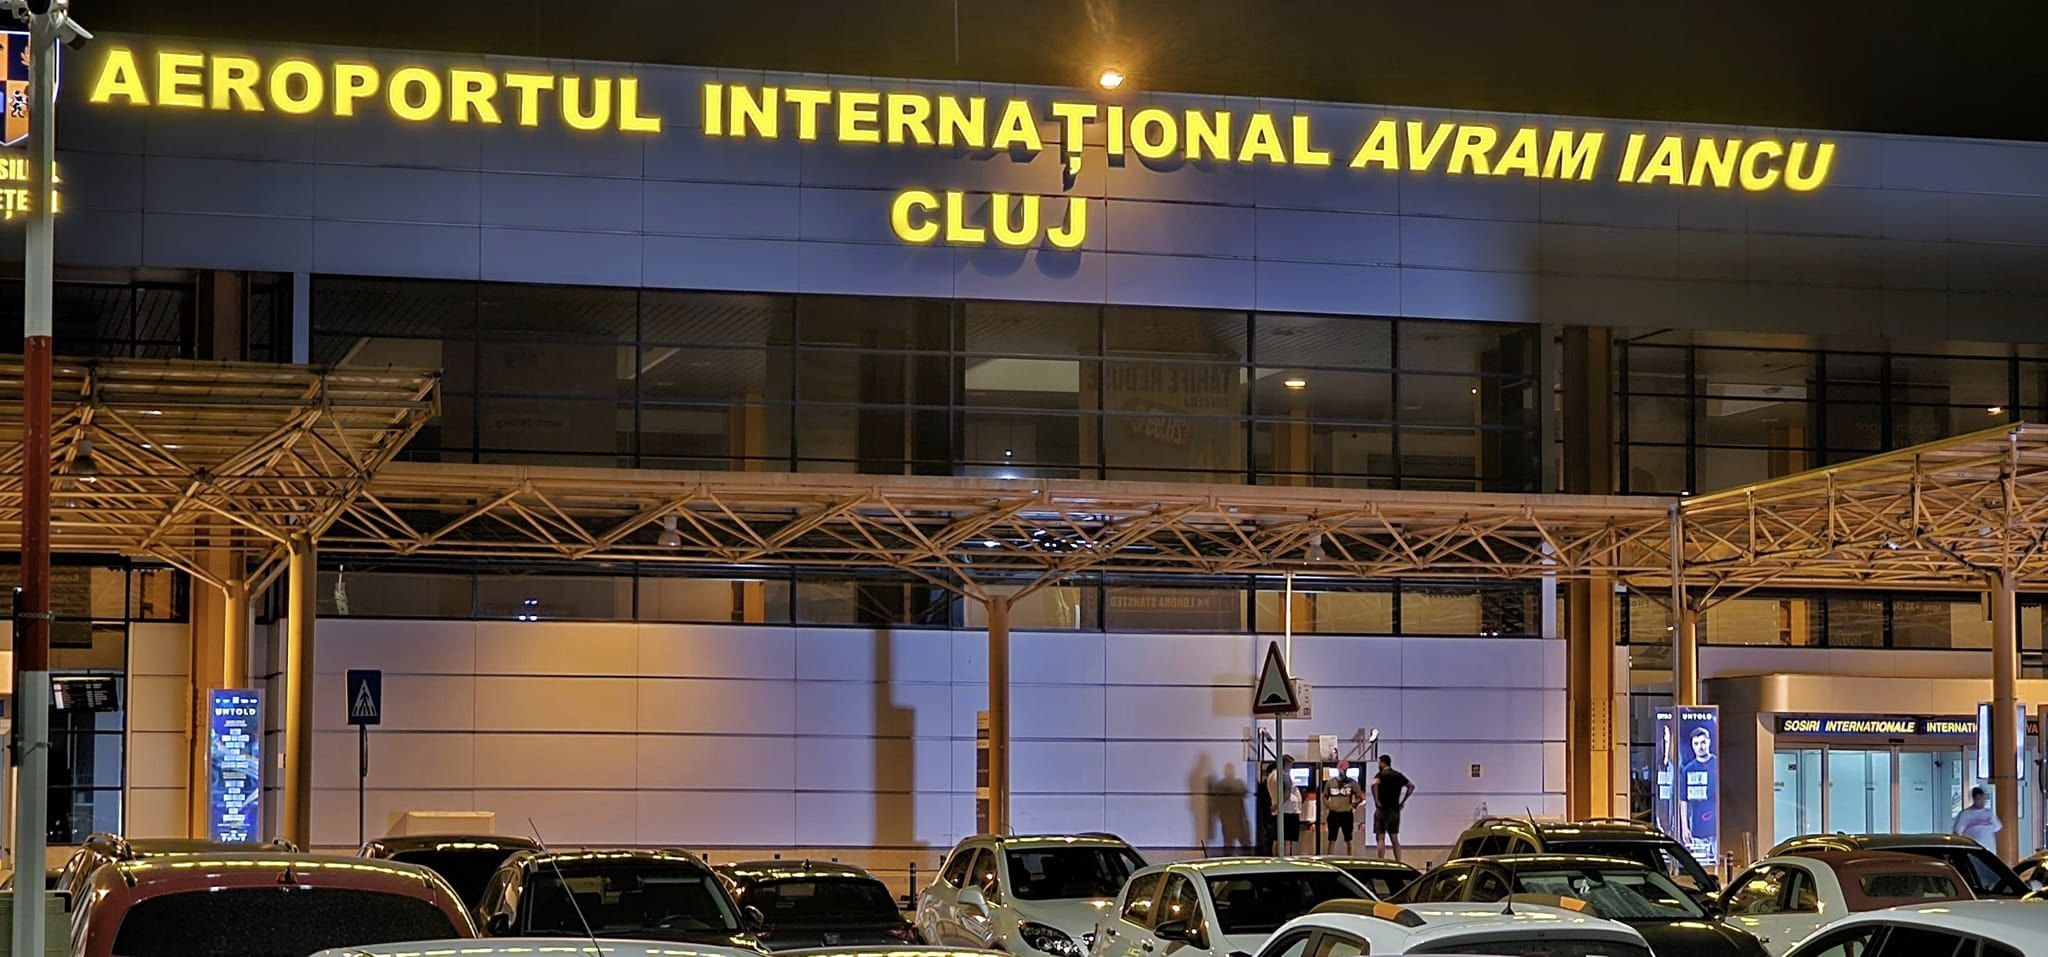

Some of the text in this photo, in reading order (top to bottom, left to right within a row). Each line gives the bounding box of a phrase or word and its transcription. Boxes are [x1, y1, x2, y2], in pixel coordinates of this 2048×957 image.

[90, 50, 1835, 191] AEROPORTUL INTERNAȚIONAL AVRAM IANCU
[891, 190, 1087, 248] CLUJ
[215, 708, 256, 716] UNTOLD
[1784, 720, 1916, 732] SOSIRI INTERNATIONALE
[1926, 722, 1977, 732] INTERNATI
